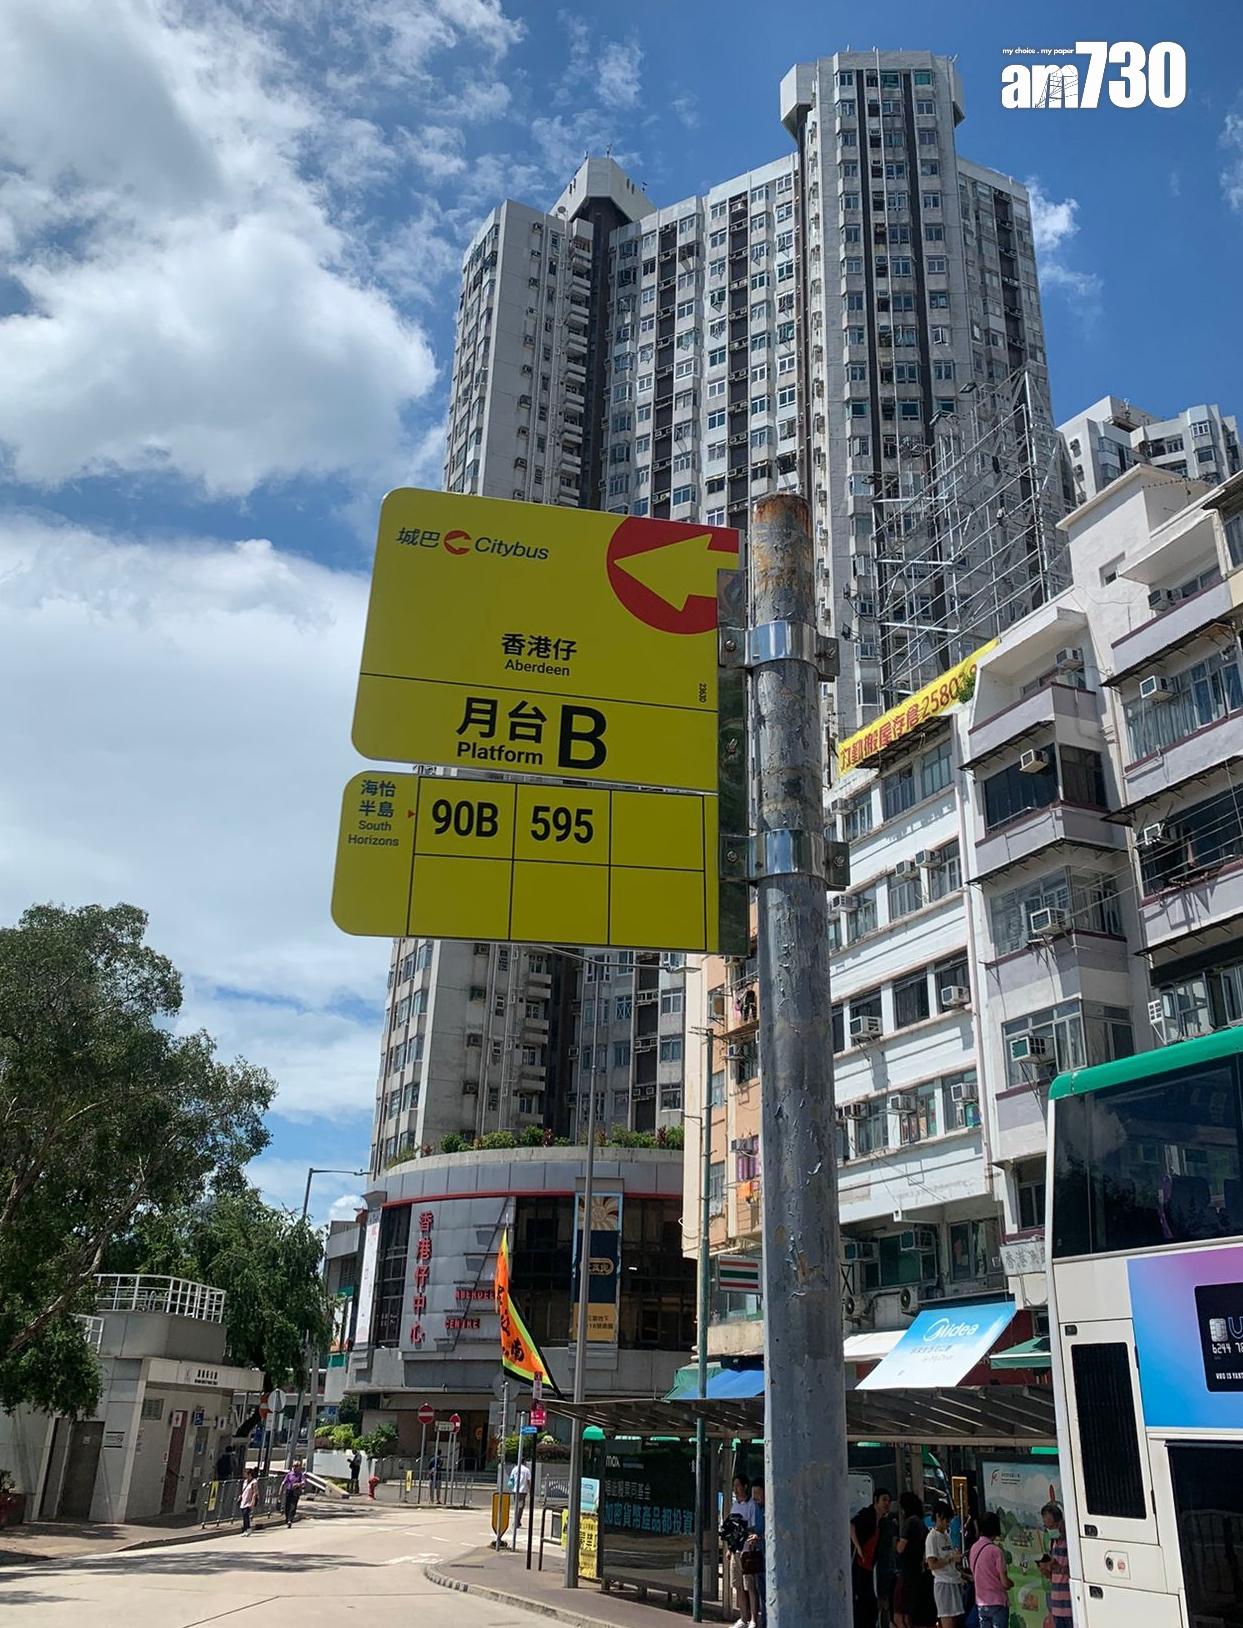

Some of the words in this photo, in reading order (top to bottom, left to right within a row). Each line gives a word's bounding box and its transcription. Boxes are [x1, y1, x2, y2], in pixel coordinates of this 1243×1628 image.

[397, 528, 440, 548] 城巴
[475, 537, 549, 560] Citybus
[502, 633, 577, 661] 香港仔
[505, 659, 570, 676] Aberdeen
[456, 697, 547, 744] 月台
[558, 704, 607, 770] B
[457, 741, 543, 765] Platform
[361, 780, 396, 797] 海怡
[359, 800, 394, 818] 半島
[432, 799, 499, 837] 90B
[358, 820, 391, 831] South
[531, 805, 594, 844] 595
[347, 833, 399, 847] Horizons
[410, 1211, 433, 1345] 香港仔中心
[453, 1289, 495, 1300] ABERDEE
[923, 1318, 979, 1341] Midea
